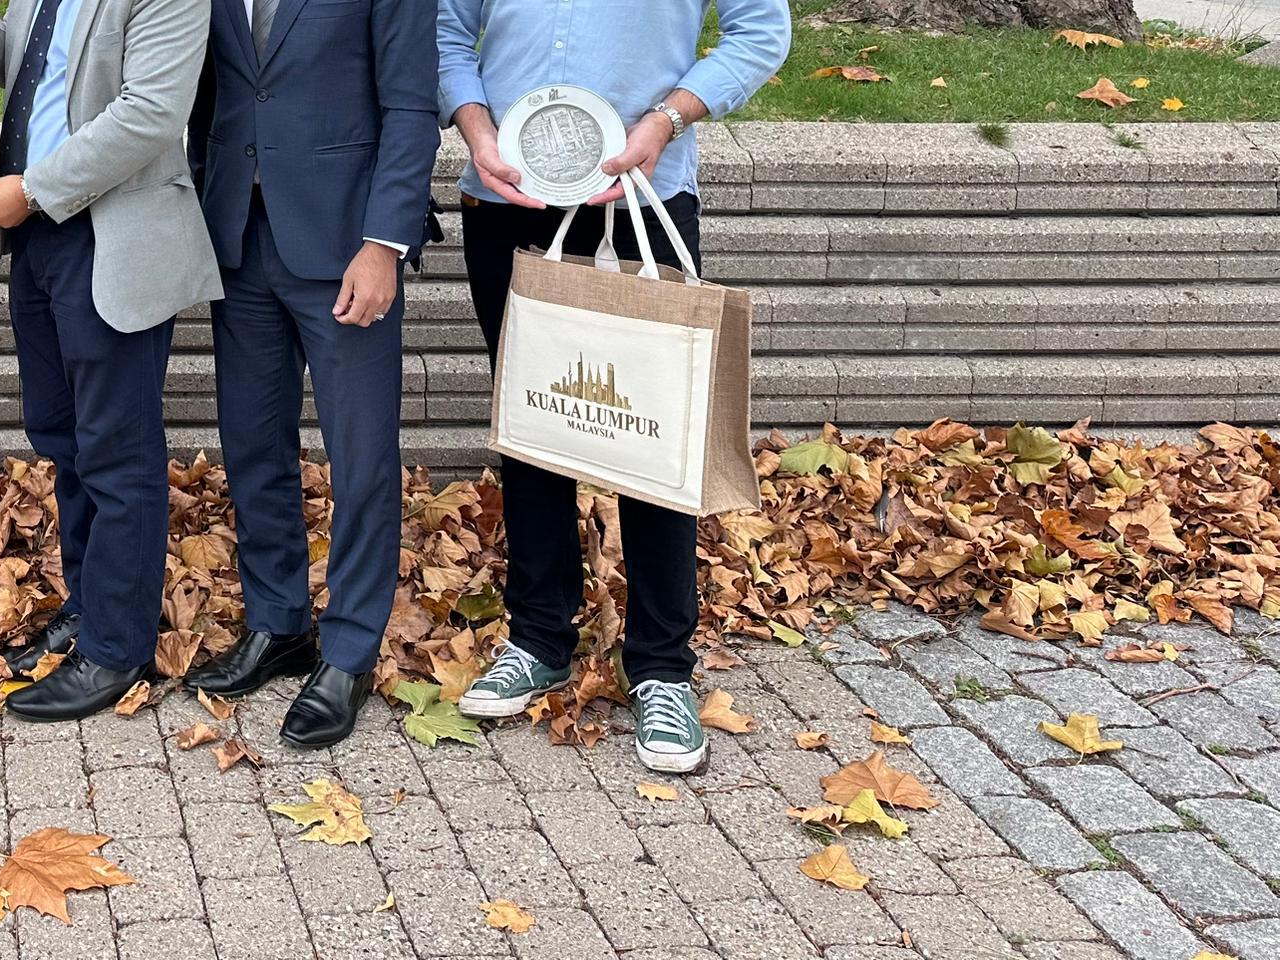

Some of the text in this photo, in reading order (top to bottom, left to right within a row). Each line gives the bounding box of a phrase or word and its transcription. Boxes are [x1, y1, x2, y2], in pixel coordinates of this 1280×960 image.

[525, 389, 661, 439] KUALA LUMPUR
[566, 419, 616, 440] MALAYSIA
